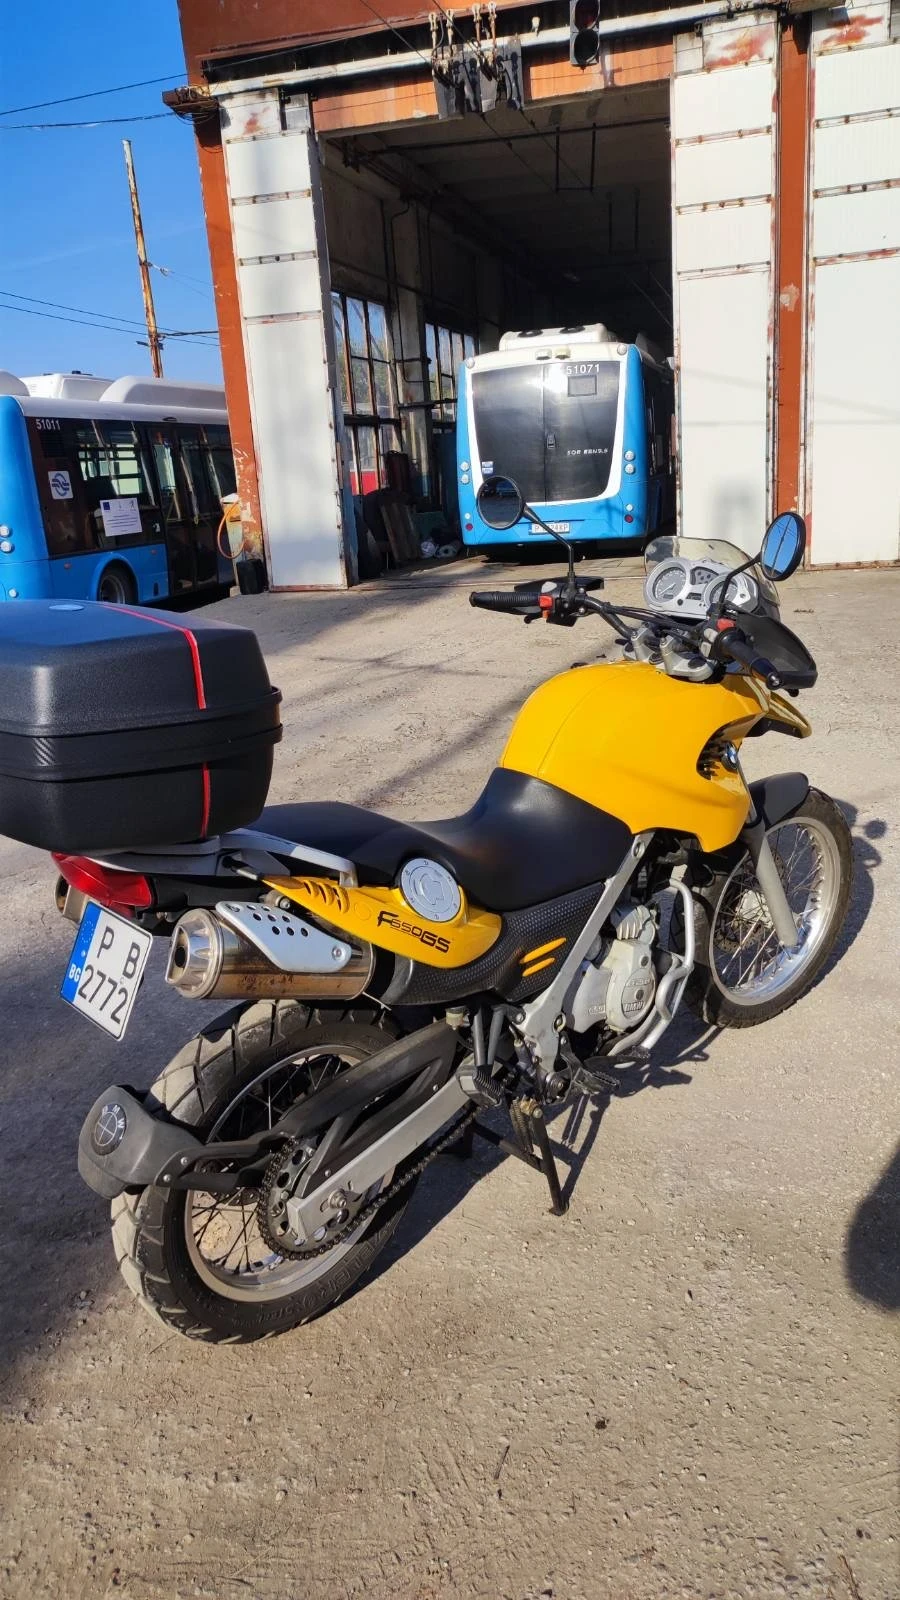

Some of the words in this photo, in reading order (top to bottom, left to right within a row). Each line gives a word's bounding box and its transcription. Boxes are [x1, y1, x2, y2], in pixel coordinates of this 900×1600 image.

[566, 363, 600, 375] 51071
[35, 418, 61, 430] 51011
[377, 910, 451, 954] F650GS
[96, 926, 115, 959] P
[122, 941, 141, 980] B
[68, 963, 82, 983] BG
[77, 964, 129, 1025] 2772
